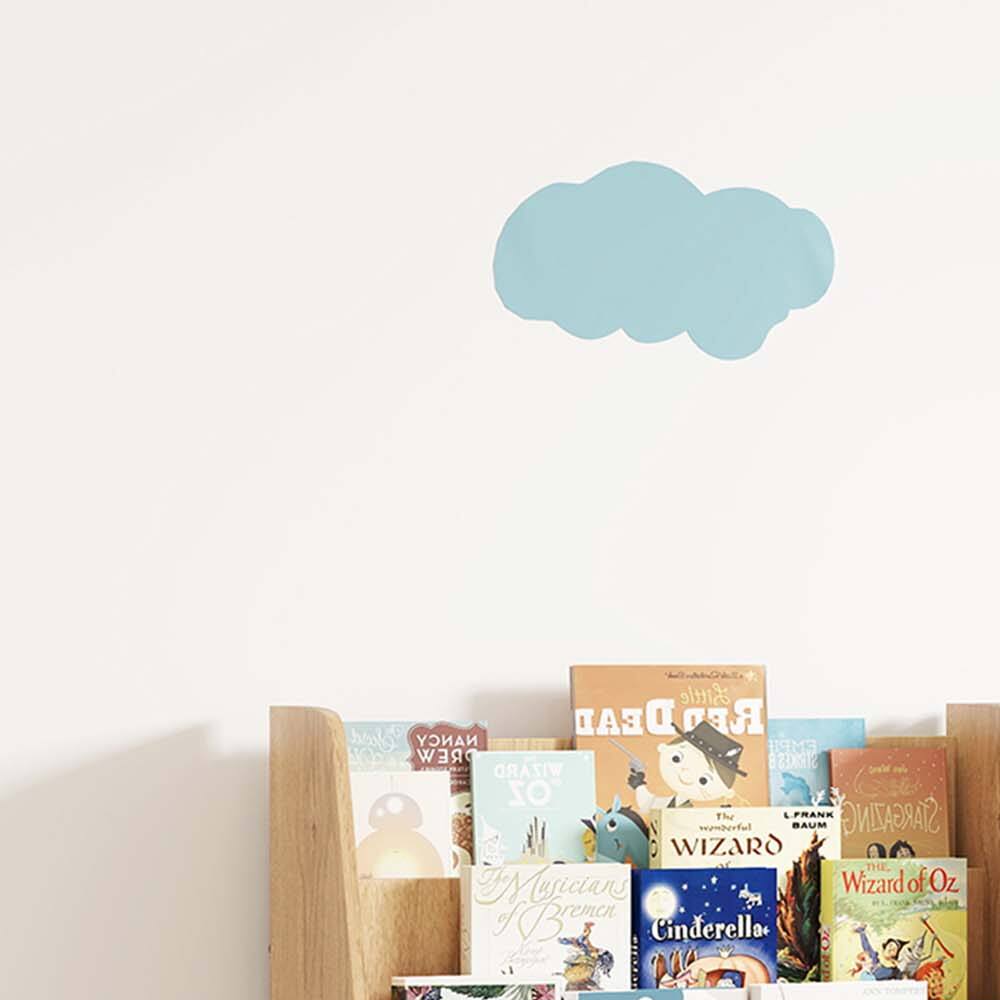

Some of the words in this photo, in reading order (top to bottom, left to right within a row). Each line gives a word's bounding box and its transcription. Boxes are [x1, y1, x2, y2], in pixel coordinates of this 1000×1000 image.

[792, 821, 828, 830] BAUM
[492, 866, 628, 903] Musicians
[842, 869, 905, 894] Wizard
[907, 868, 927, 894] of
[929, 866, 960, 893] Oz
[493, 901, 525, 937] of
[518, 897, 616, 942] Bremen
[651, 915, 764, 943] Cinderella
